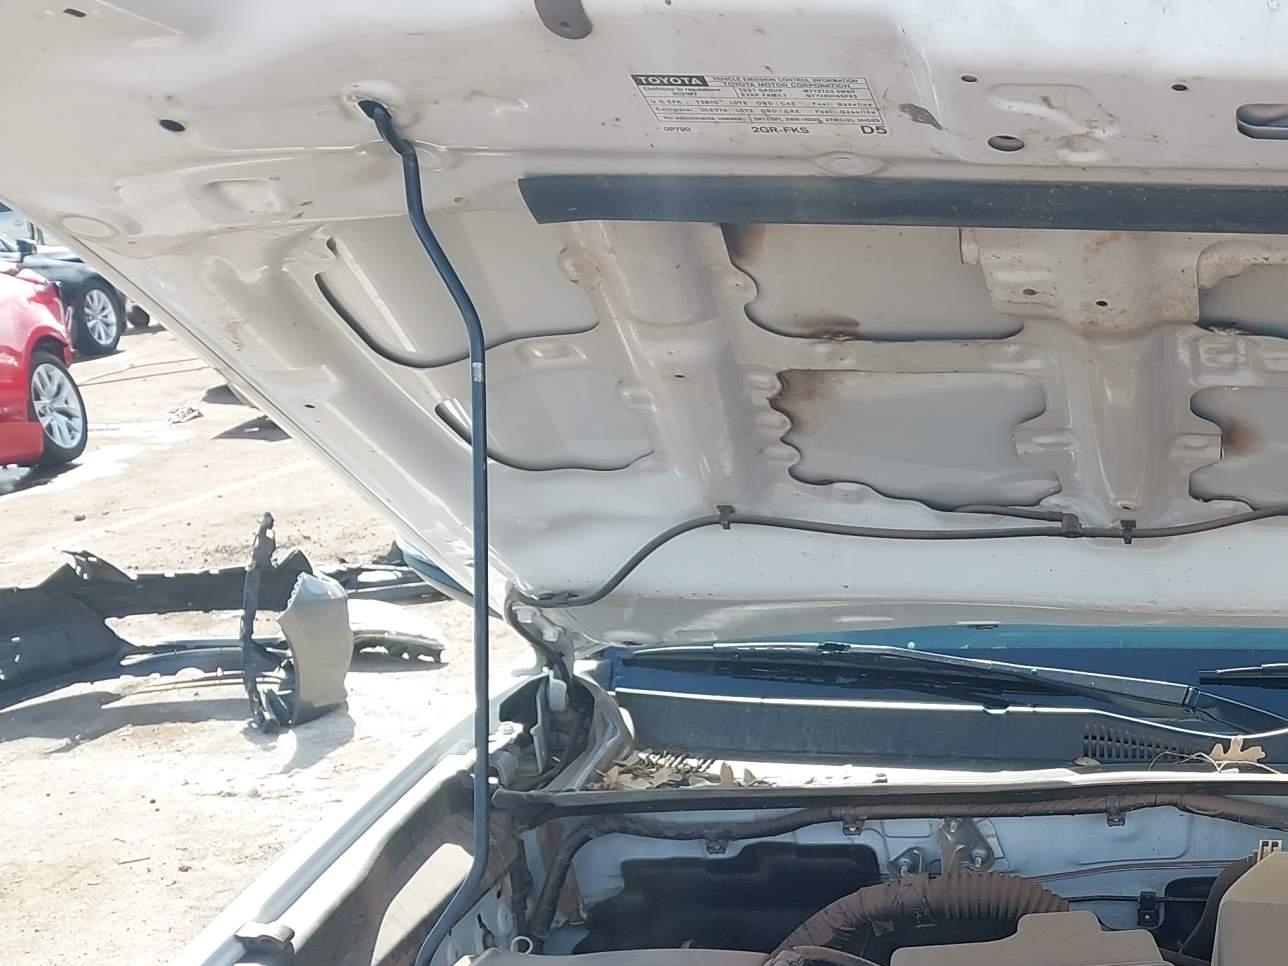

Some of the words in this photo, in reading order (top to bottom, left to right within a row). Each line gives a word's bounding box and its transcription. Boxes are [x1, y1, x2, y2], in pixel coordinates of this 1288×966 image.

[638, 76, 703, 85] TOYOTA
[751, 126, 810, 134] 2GR-FKS
[860, 125, 888, 135] D5
